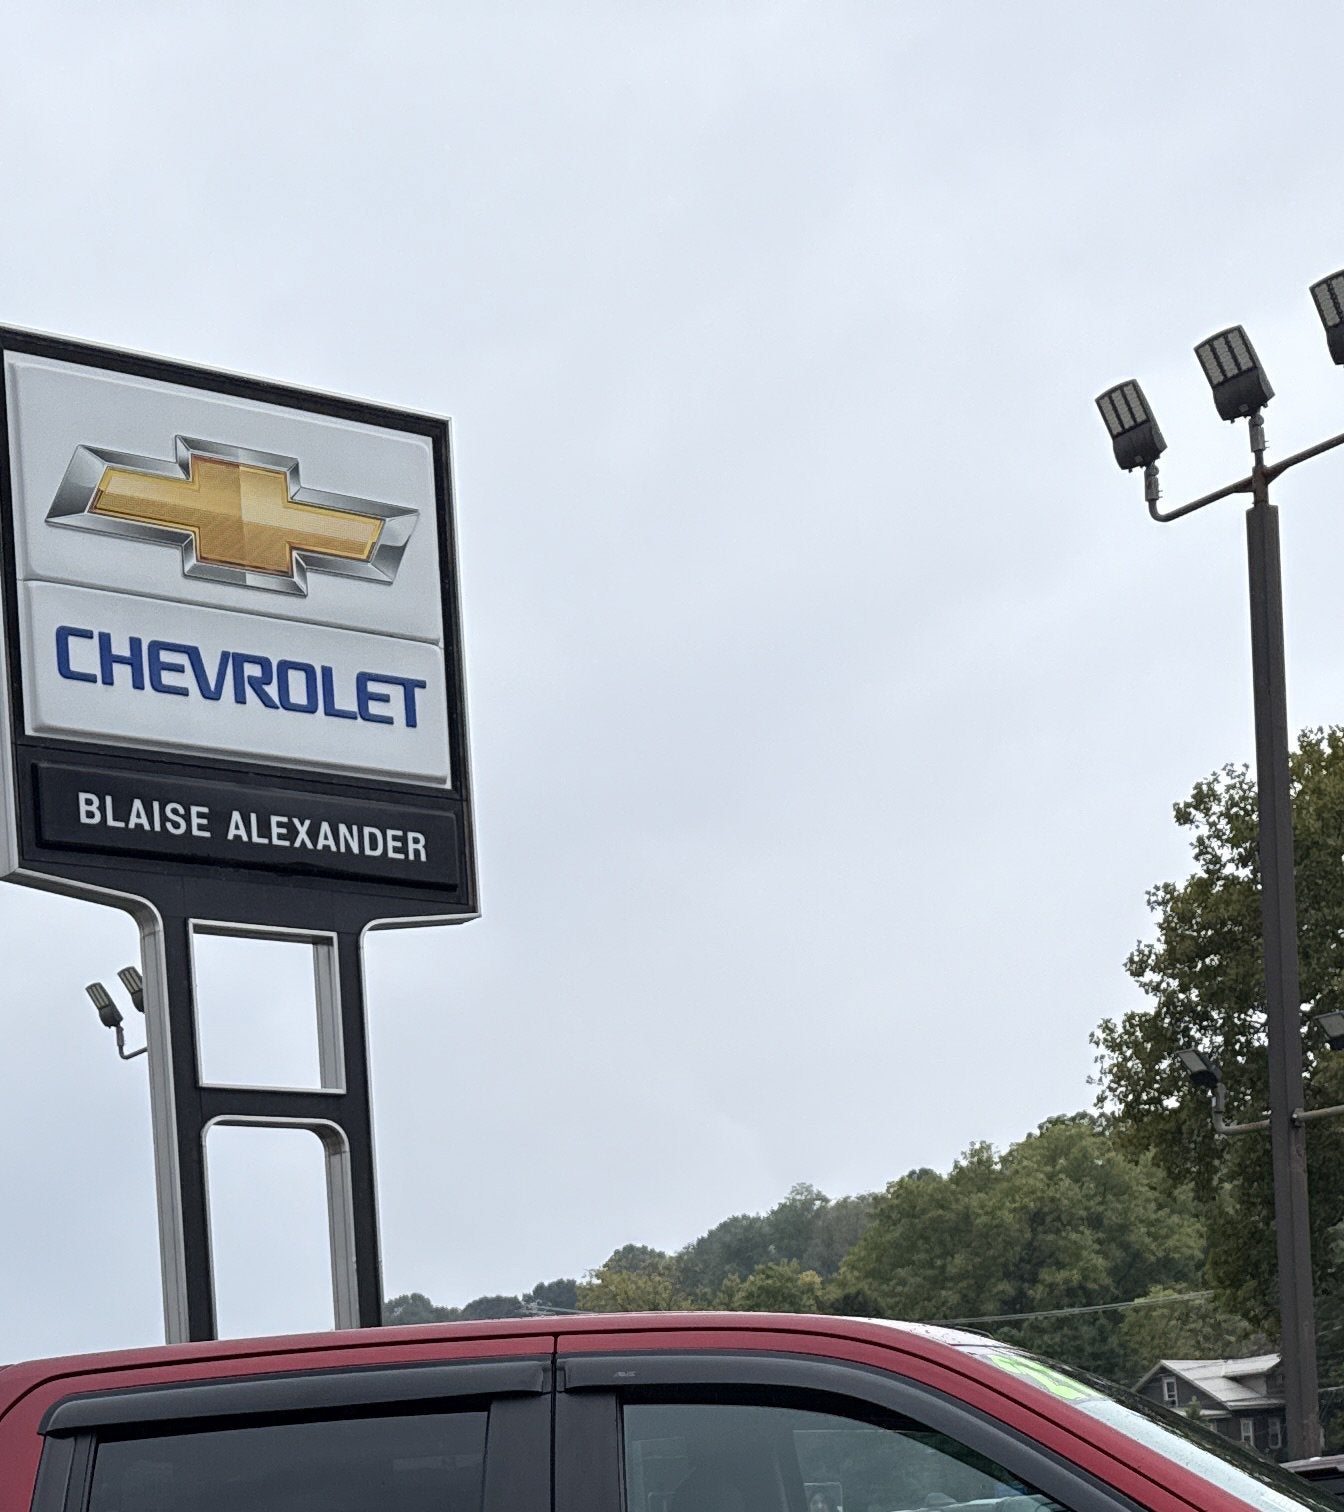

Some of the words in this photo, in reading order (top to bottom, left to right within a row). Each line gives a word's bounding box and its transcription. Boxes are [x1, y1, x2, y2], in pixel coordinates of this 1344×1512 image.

[56, 625, 427, 728] CHEVROLET
[78, 792, 212, 838] BLAISE
[227, 810, 428, 862] ALEXANDER
